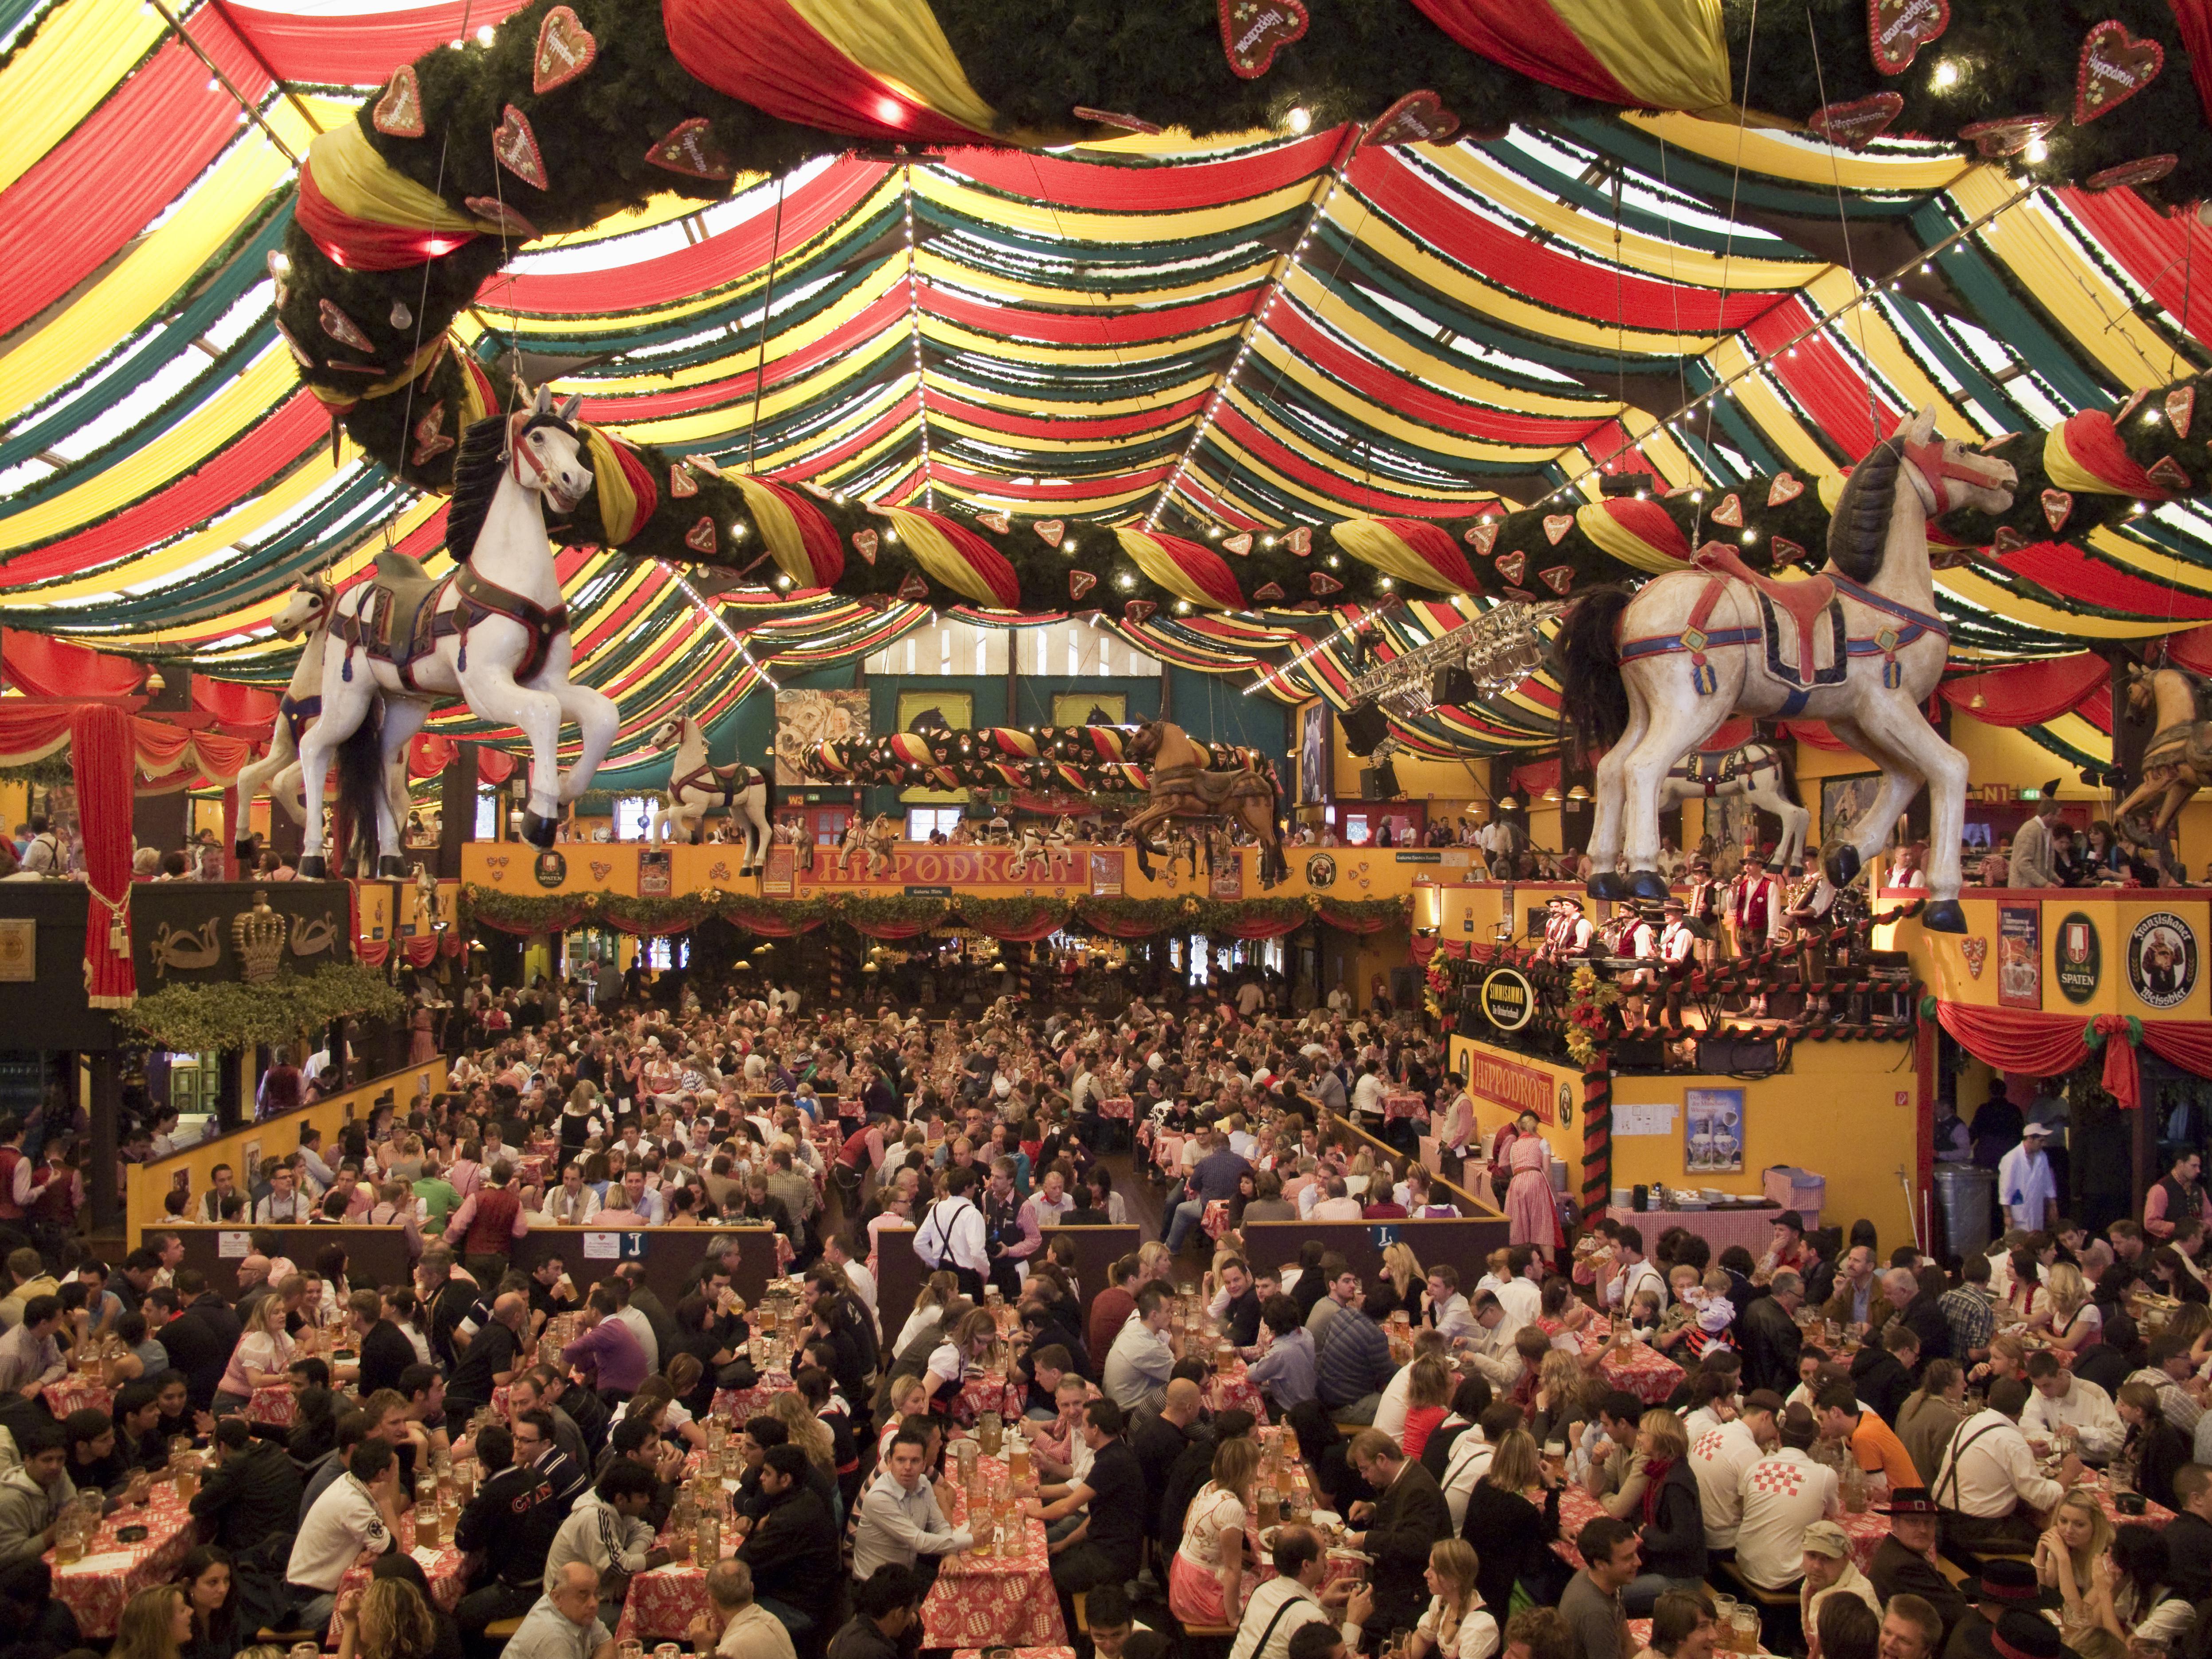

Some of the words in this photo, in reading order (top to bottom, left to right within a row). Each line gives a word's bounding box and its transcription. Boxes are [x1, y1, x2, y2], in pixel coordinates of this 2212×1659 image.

[2088, 50, 2135, 88] Hippodrom
[788, 796, 804, 805] W3
[1985, 786, 2007, 802] N1
[2133, 914, 2192, 941] Franziskaner
[2062, 973, 2095, 986] SPATEN
[1490, 982, 1523, 1005] SIMMISAMMA
[2140, 986, 2188, 1006] Weissbier
[628, 1233, 642, 1256] J
[1378, 1227, 1393, 1247] L
